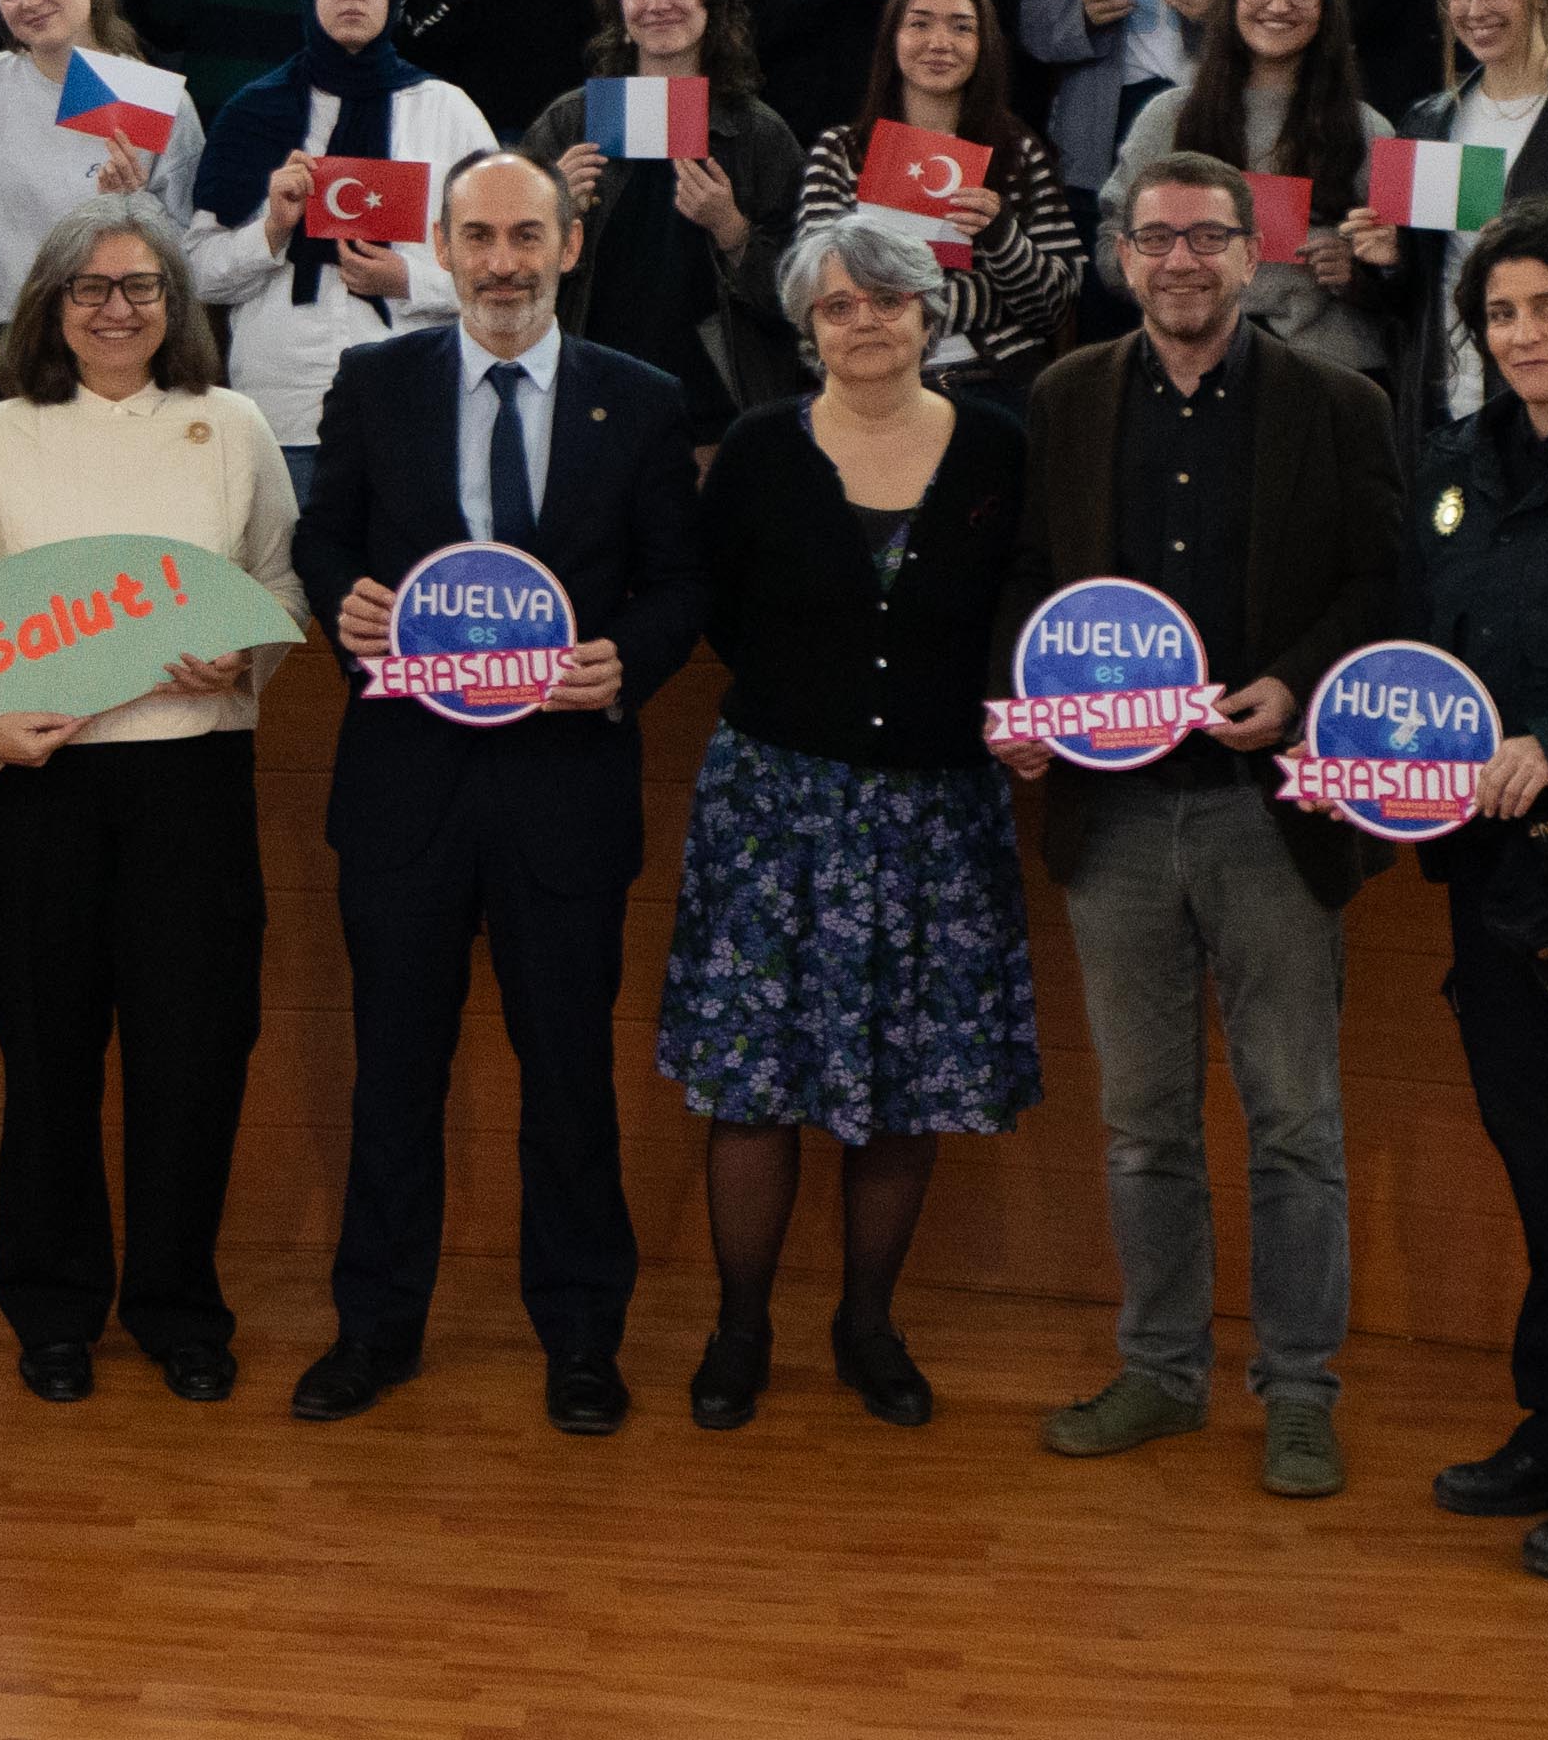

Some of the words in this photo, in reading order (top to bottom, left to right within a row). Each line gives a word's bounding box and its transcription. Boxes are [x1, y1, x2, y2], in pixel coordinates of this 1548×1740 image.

[413, 582, 554, 622] HUELVA
[468, 626, 498, 645] es
[1039, 620, 1182, 659] HUELVA
[1095, 665, 1125, 684] es
[1006, 685, 1210, 740] ERASMUS
[1333, 678, 1480, 733] HUELVA
[1298, 754, 1476, 802] ERASMU
